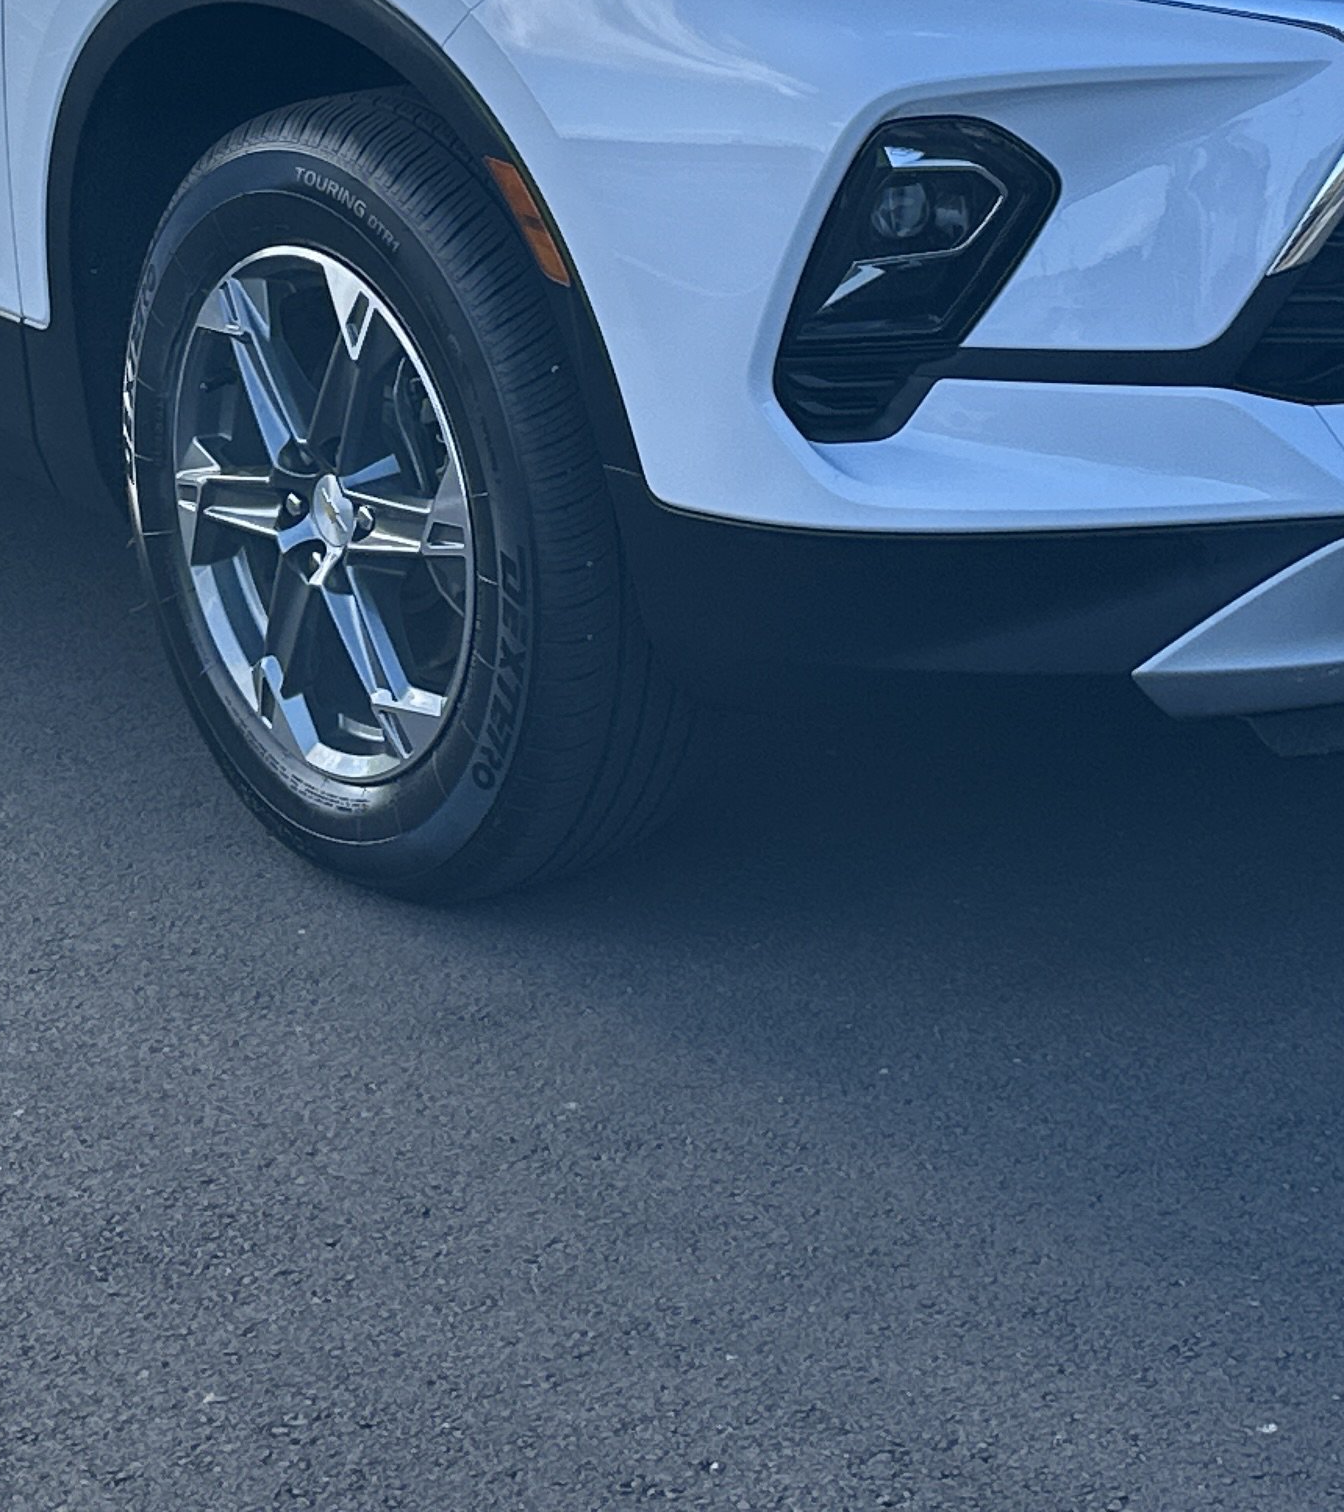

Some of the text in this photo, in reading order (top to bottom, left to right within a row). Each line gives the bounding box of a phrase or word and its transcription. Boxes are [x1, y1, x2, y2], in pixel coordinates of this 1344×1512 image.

[294, 166, 401, 253] TOURING DTR1
[471, 544, 528, 792] DEXTERO
